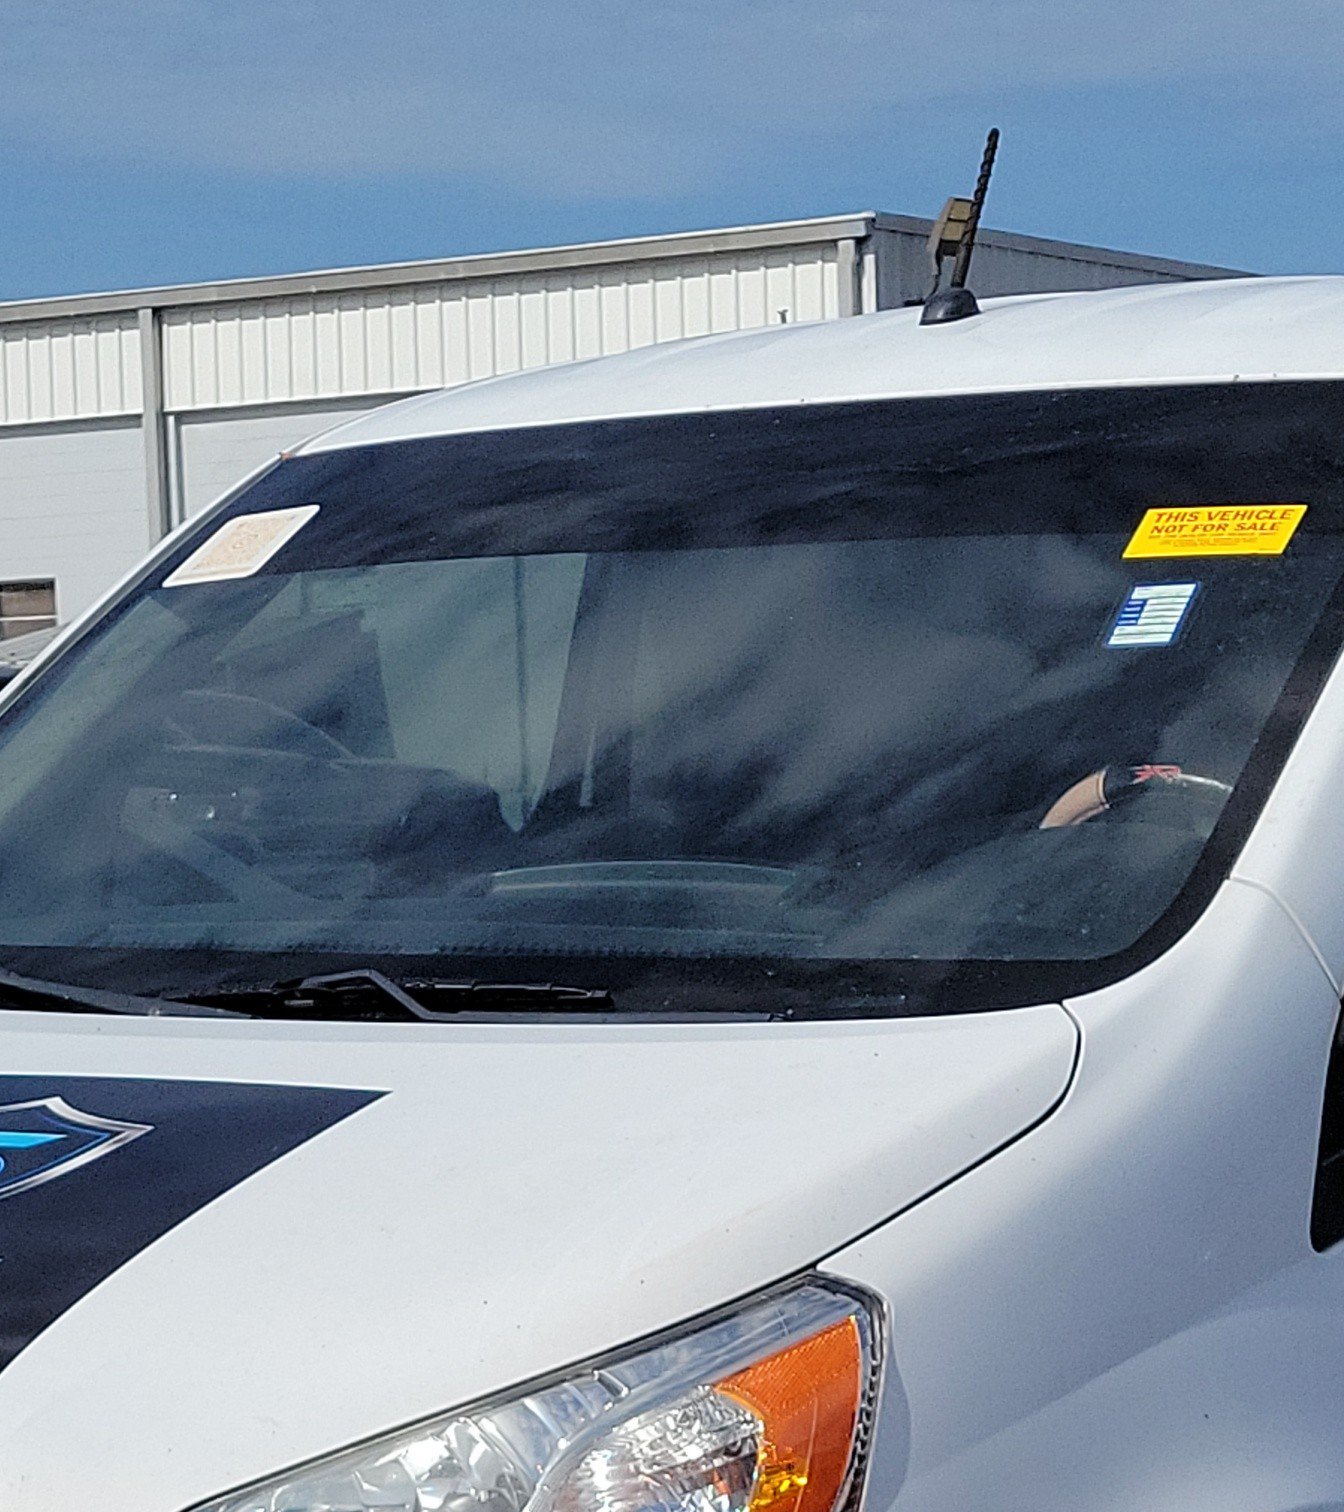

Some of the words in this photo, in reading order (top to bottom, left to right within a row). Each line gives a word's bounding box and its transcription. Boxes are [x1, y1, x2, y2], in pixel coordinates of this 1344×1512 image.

[1154, 511, 1199, 523] THIS
[1207, 508, 1296, 521] VEHICLE
[1150, 523, 1189, 534] NOT
[1190, 523, 1231, 533] FOR
[1234, 521, 1283, 532] SALE
